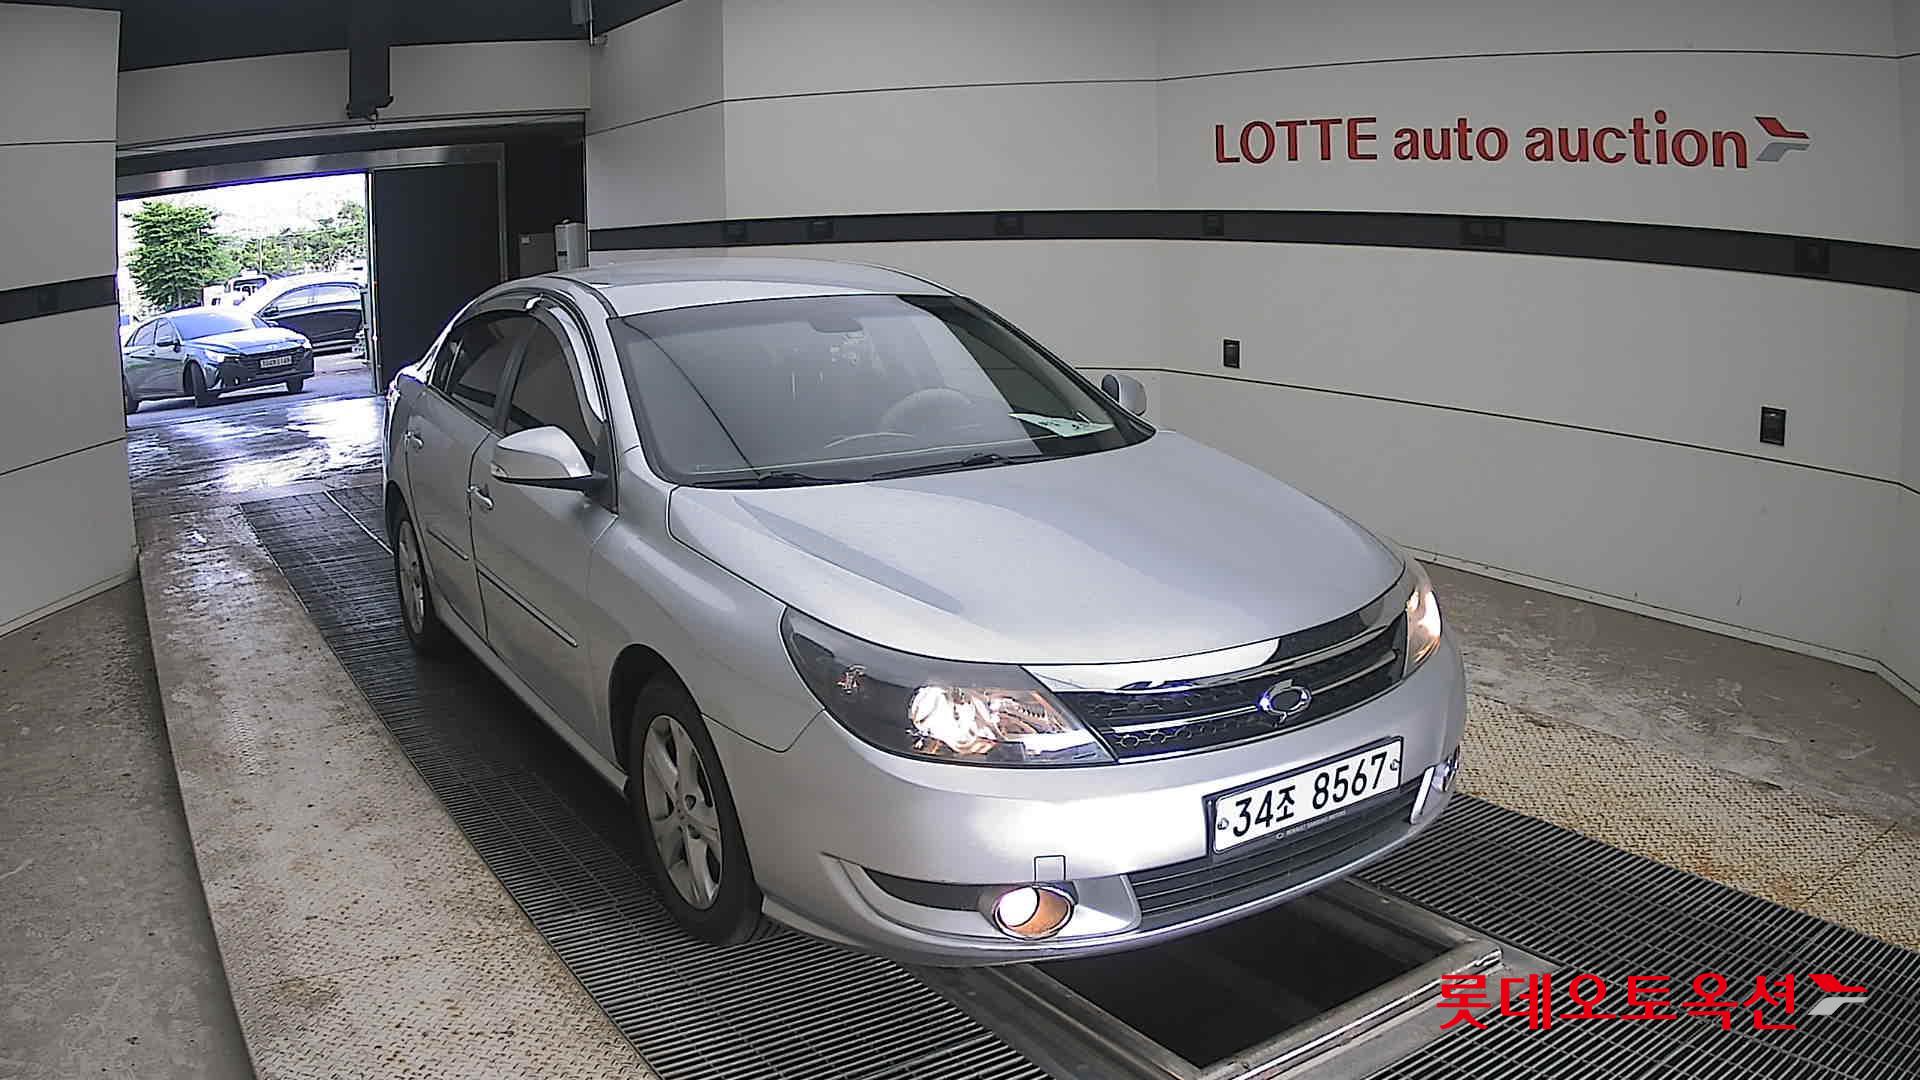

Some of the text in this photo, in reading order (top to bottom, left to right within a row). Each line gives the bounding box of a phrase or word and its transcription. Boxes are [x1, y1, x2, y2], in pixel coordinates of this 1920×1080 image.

[1216, 110, 1747, 168] LOTTE auto auction
[1233, 785, 1296, 836] 34조
[1312, 751, 1388, 810] 8567
